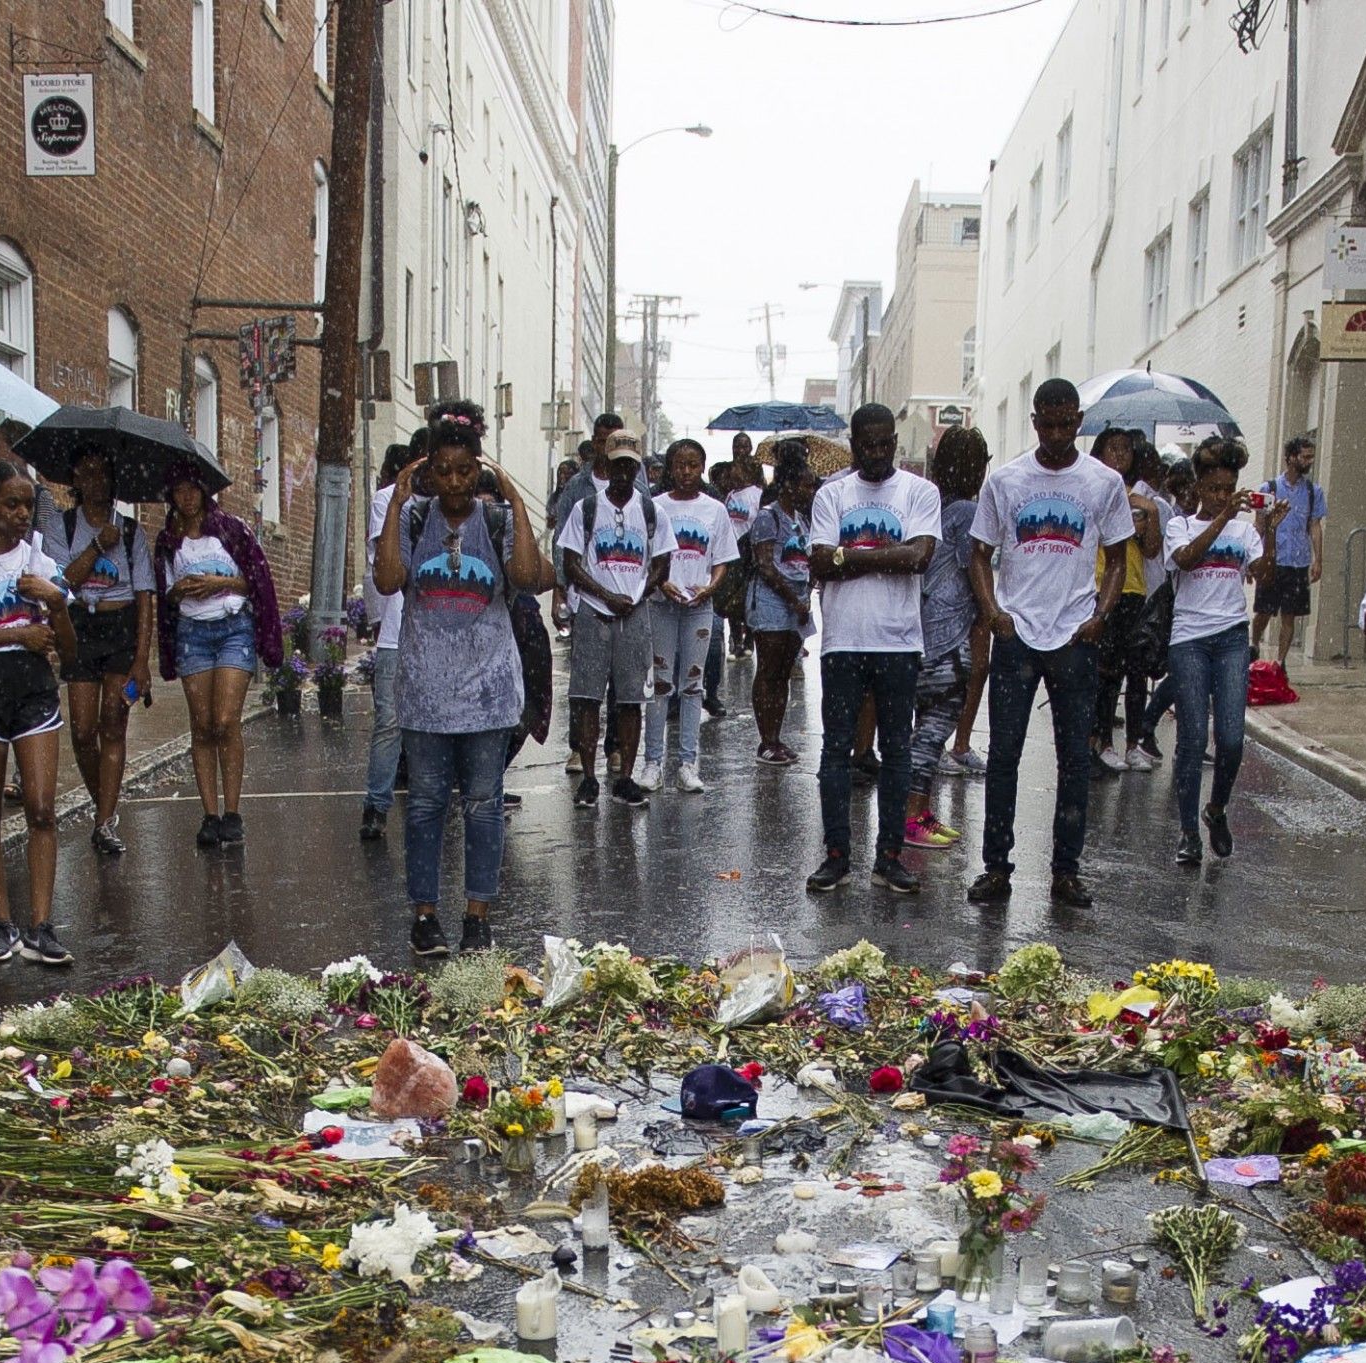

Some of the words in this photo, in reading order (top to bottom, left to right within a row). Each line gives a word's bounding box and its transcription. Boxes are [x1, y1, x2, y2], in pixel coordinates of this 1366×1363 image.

[30, 80, 61, 88] RECORD
[39, 103, 78, 117] MELODY
[1023, 545, 1036, 555] DAY
[1037, 543, 1048, 554] OF
[1049, 543, 1074, 556] SERVICE
